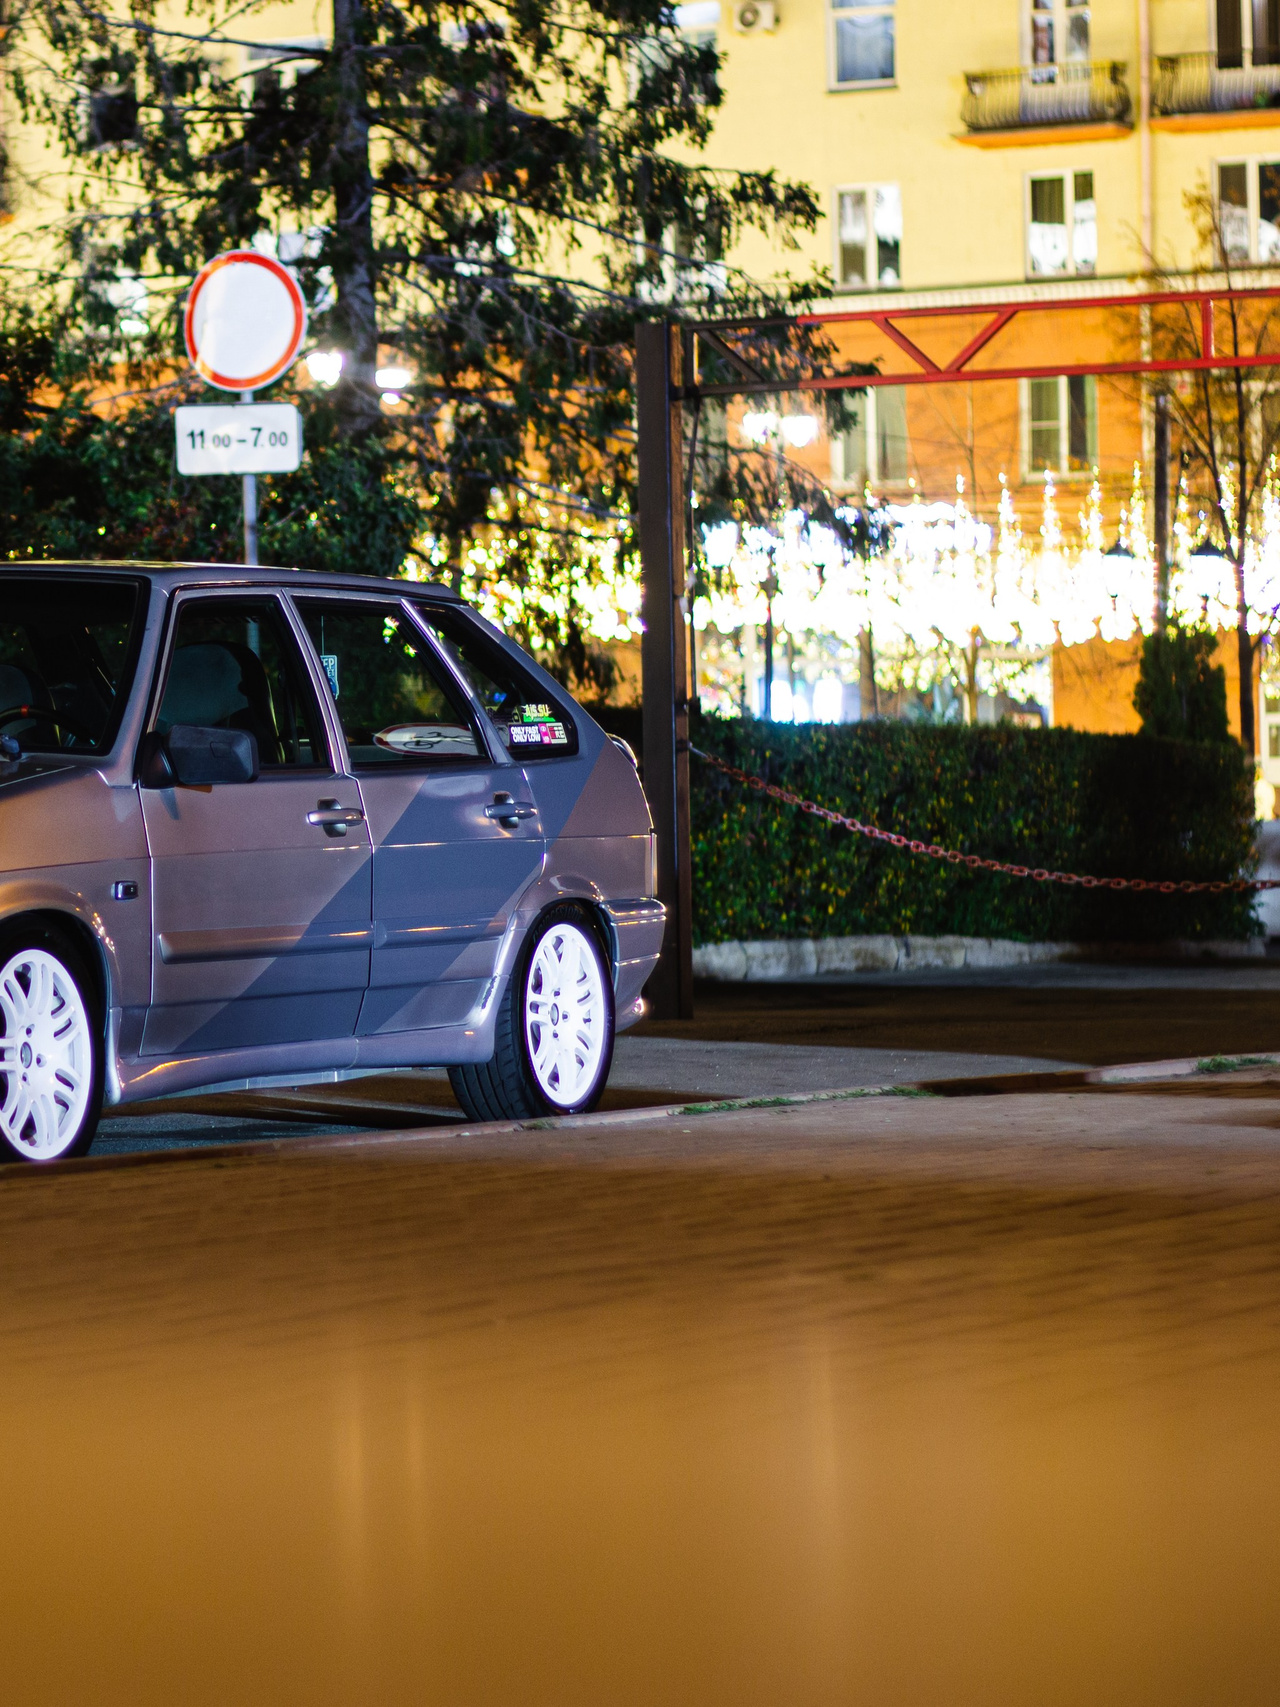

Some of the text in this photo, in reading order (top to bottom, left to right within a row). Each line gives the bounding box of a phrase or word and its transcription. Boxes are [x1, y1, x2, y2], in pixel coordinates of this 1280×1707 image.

[511, 726, 525, 735] ONLY
[526, 725, 539, 734] FAST
[513, 733, 541, 743] ONLY LOW
